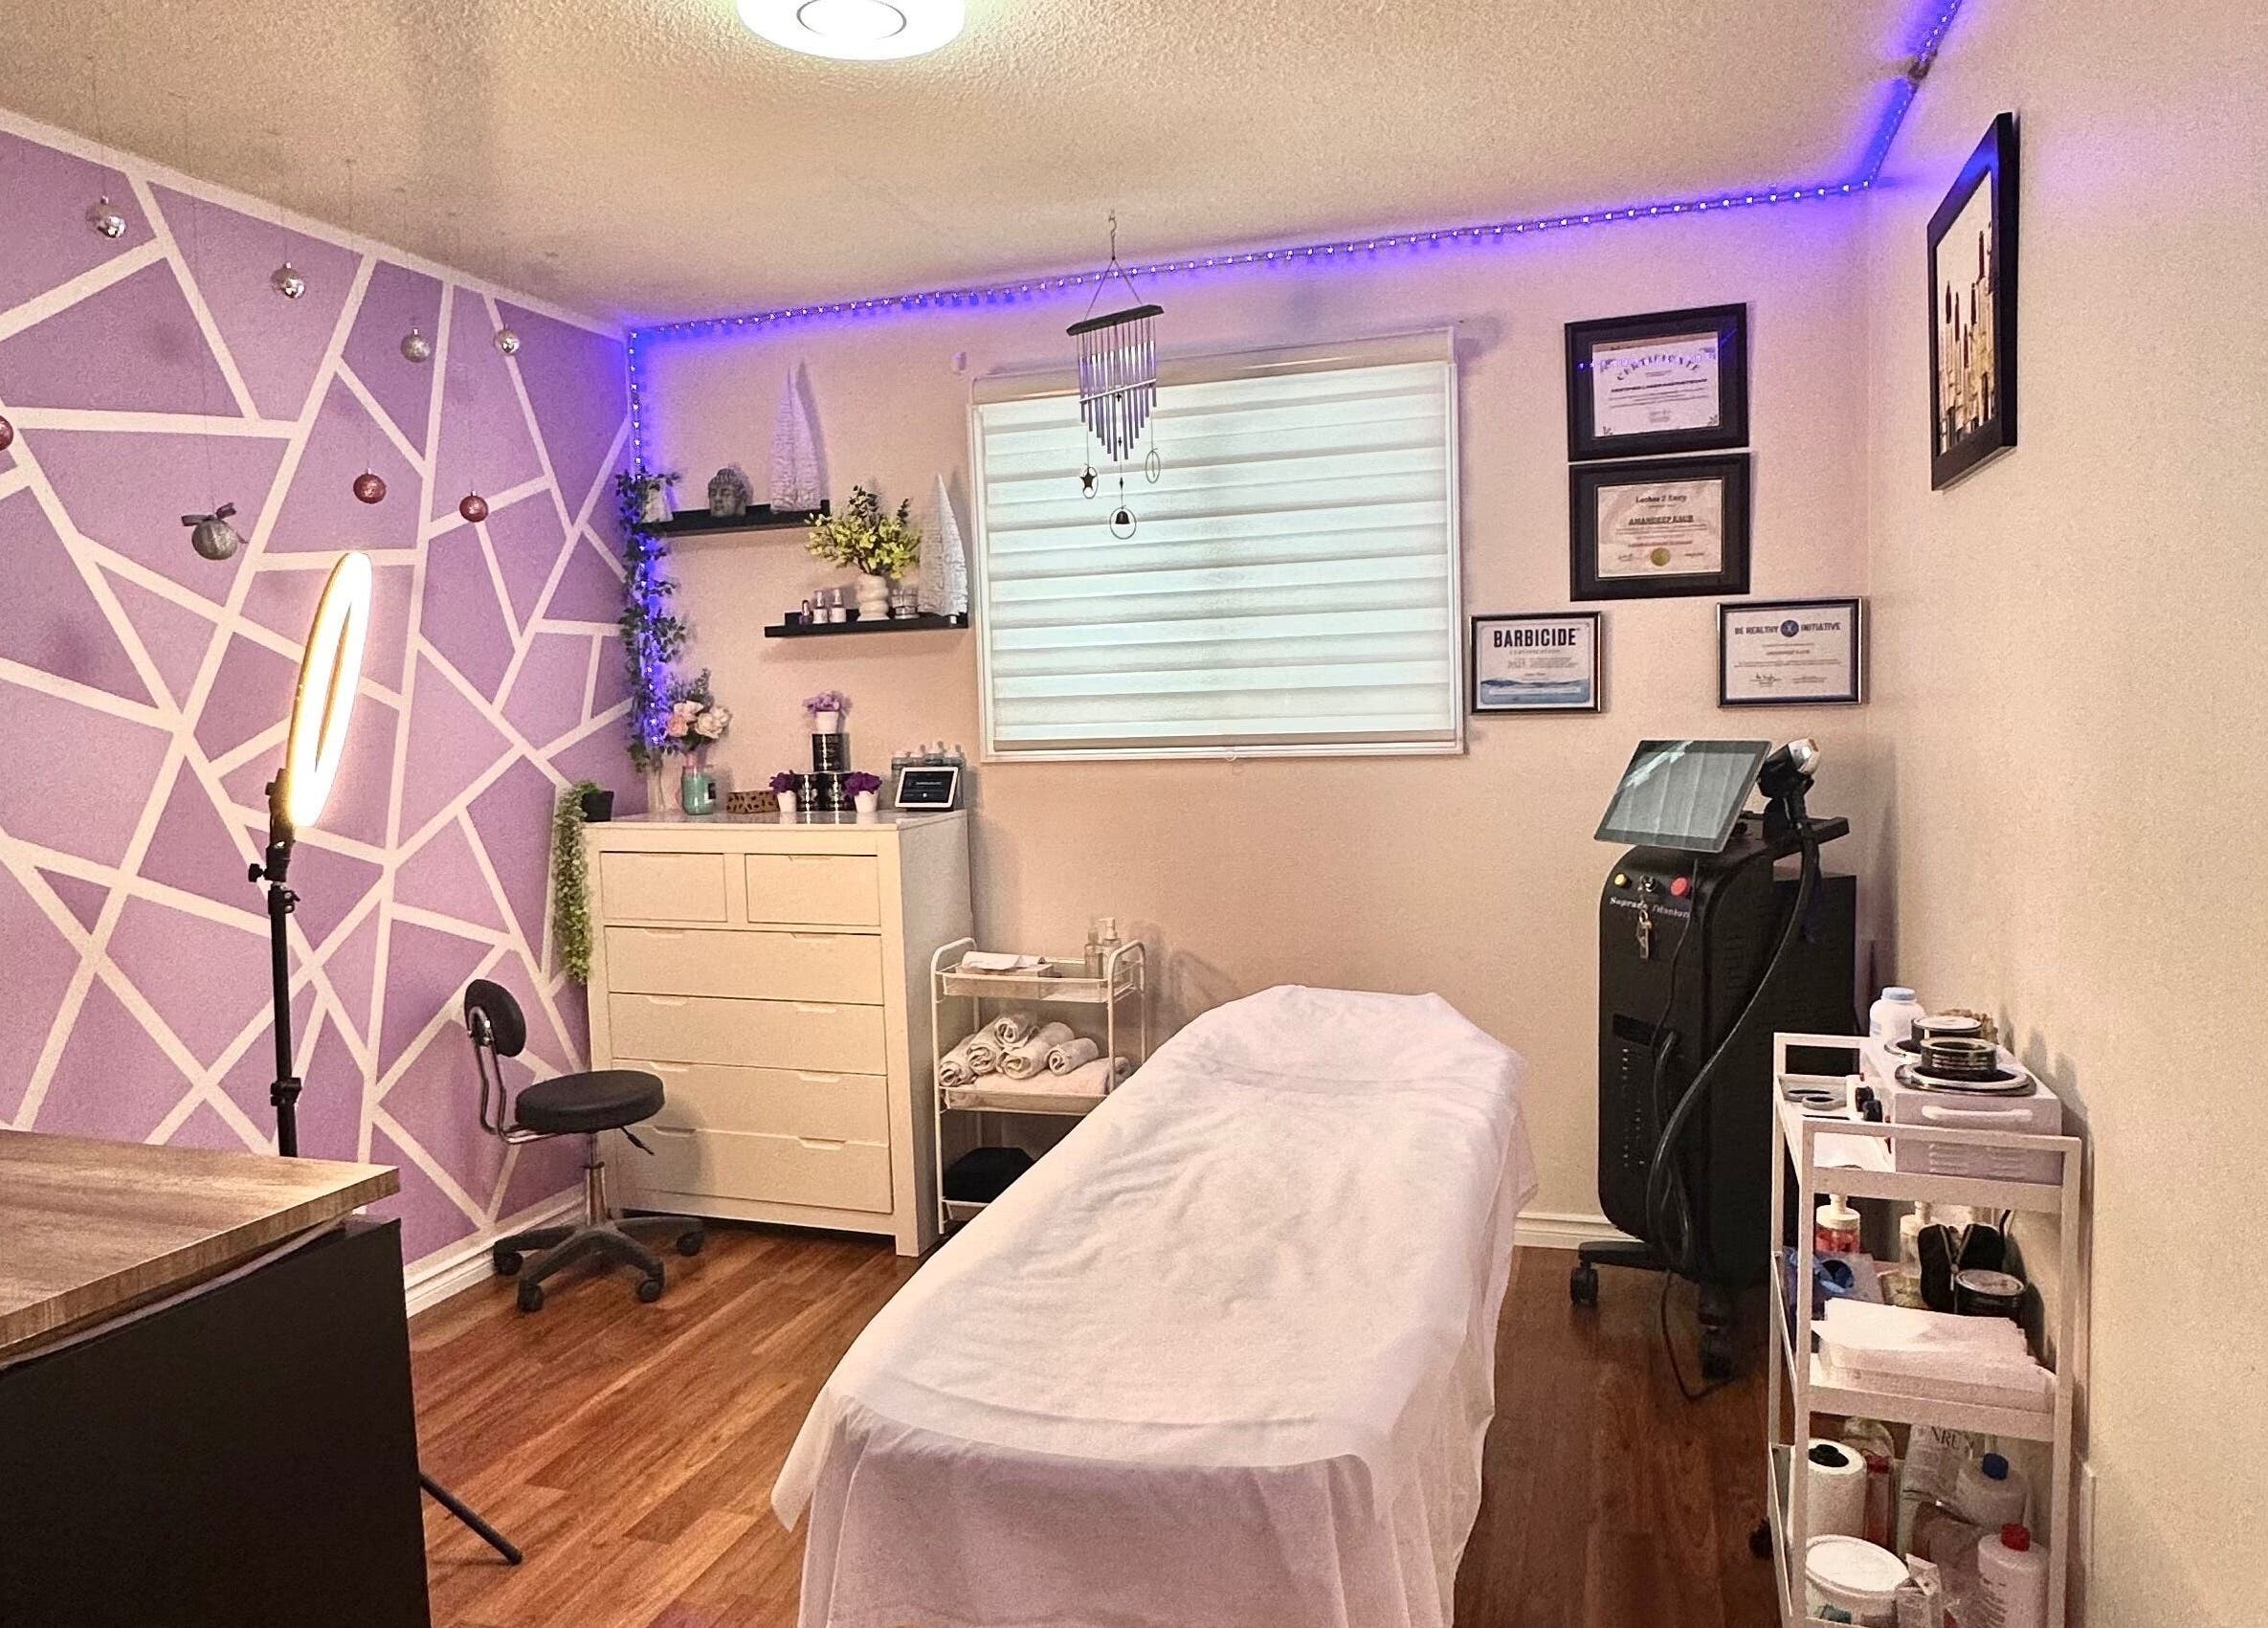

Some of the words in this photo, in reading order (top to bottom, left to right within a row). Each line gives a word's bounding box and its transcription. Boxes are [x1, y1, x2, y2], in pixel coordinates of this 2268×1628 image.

[1745, 625, 1779, 635] HEALTHY
[1800, 622, 1841, 632] INITIATIVE
[1493, 628, 1577, 648] BARBICIDE
